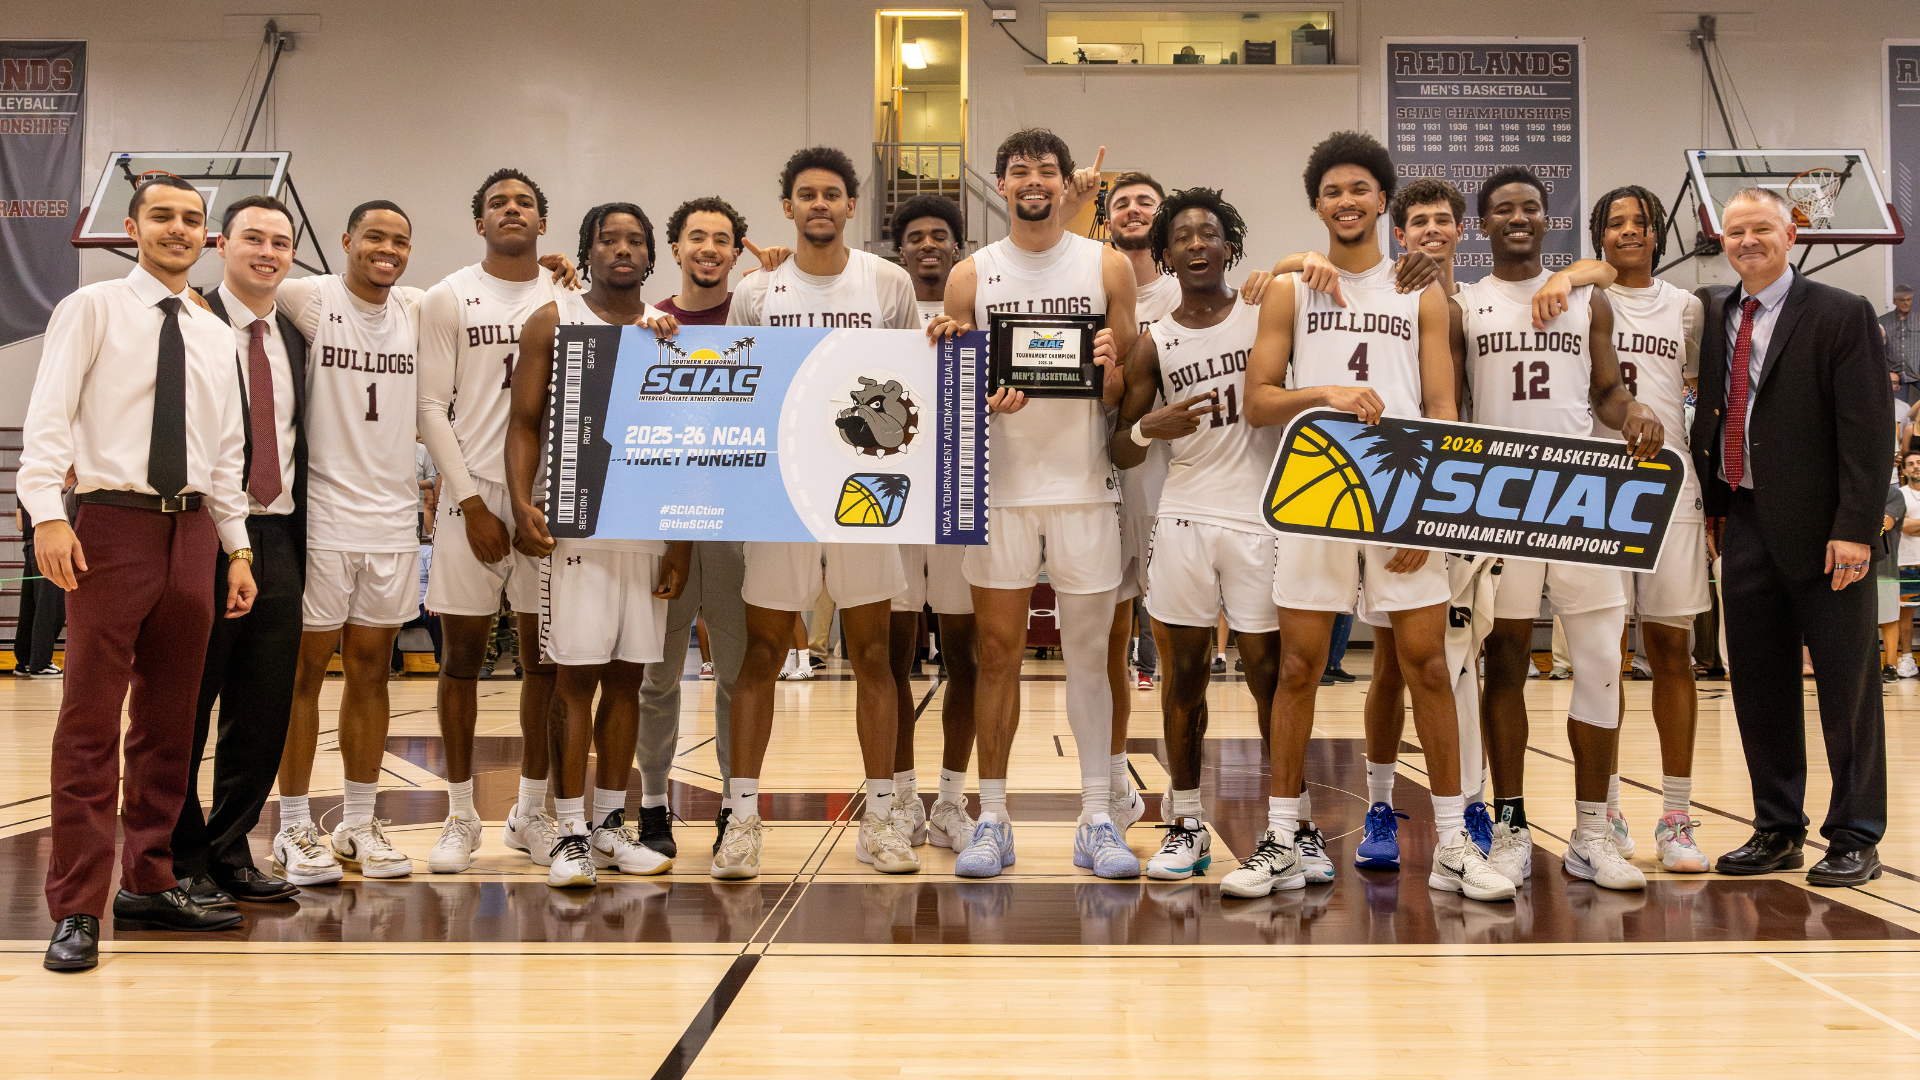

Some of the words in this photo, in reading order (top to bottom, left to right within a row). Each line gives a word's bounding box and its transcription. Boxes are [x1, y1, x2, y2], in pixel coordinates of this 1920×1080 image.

[0, 59, 73, 91] NDS
[1395, 51, 1571, 76] REDLANDS
[1420, 85, 1460, 96] MEN'S
[1463, 85, 1547, 96] BASKETBALL
[1396, 107, 1441, 120] SCIAC
[1445, 107, 1571, 120] CHAMPIONSHIPS
[1397, 123, 1416, 131] 1930
[1422, 123, 1441, 131] 1931
[1474, 123, 1493, 131] 1941
[1397, 144, 1416, 152] 1985
[1422, 144, 1441, 152] 1990
[1449, 144, 1468, 152] 2011
[1474, 144, 1493, 152] 2013
[1396, 164, 1446, 177] SCIAC
[1307, 311, 1411, 341] BULLDOGS
[588, 338, 596, 348] 22
[1029, 339, 1064, 348] SCIAC
[1476, 332, 1582, 357] BULLDOGS
[1613, 332, 1679, 360] LDOGS
[321, 346, 414, 375] BULLDOGS
[587, 350, 595, 369] SEAT
[1168, 348, 1252, 393] BULLDO
[1347, 343, 1369, 381] 4
[642, 366, 760, 395] SCIAC
[1011, 371, 1035, 381] MEN'S
[1036, 372, 1080, 382] BASKETBALL
[1512, 361, 1550, 401] 12
[365, 383, 378, 421] 1
[943, 388, 953, 440] AUTOMATIC
[1210, 383, 1239, 429] 11
[584, 416, 592, 425] 13
[583, 427, 591, 445] ROW
[624, 426, 706, 445] 2025-26
[712, 427, 766, 446] NCAA
[624, 448, 684, 466] TICKET
[686, 449, 767, 467] PUNCHED
[1440, 435, 1484, 454] 2026
[1487, 440, 1538, 461] MEN'S
[1541, 446, 1634, 471] BASKETBALL
[943, 443, 952, 508] TOURNAMENT
[1421, 460, 1667, 534] SCIAC
[579, 497, 588, 530] SECTION
[659, 505, 725, 516] #SCIACtion
[943, 510, 952, 536] NCAA
[658, 519, 724, 531] @theSCIAC
[1415, 519, 1524, 546] TOURNAMENT
[1526, 532, 1620, 555] CHAMPIONS
